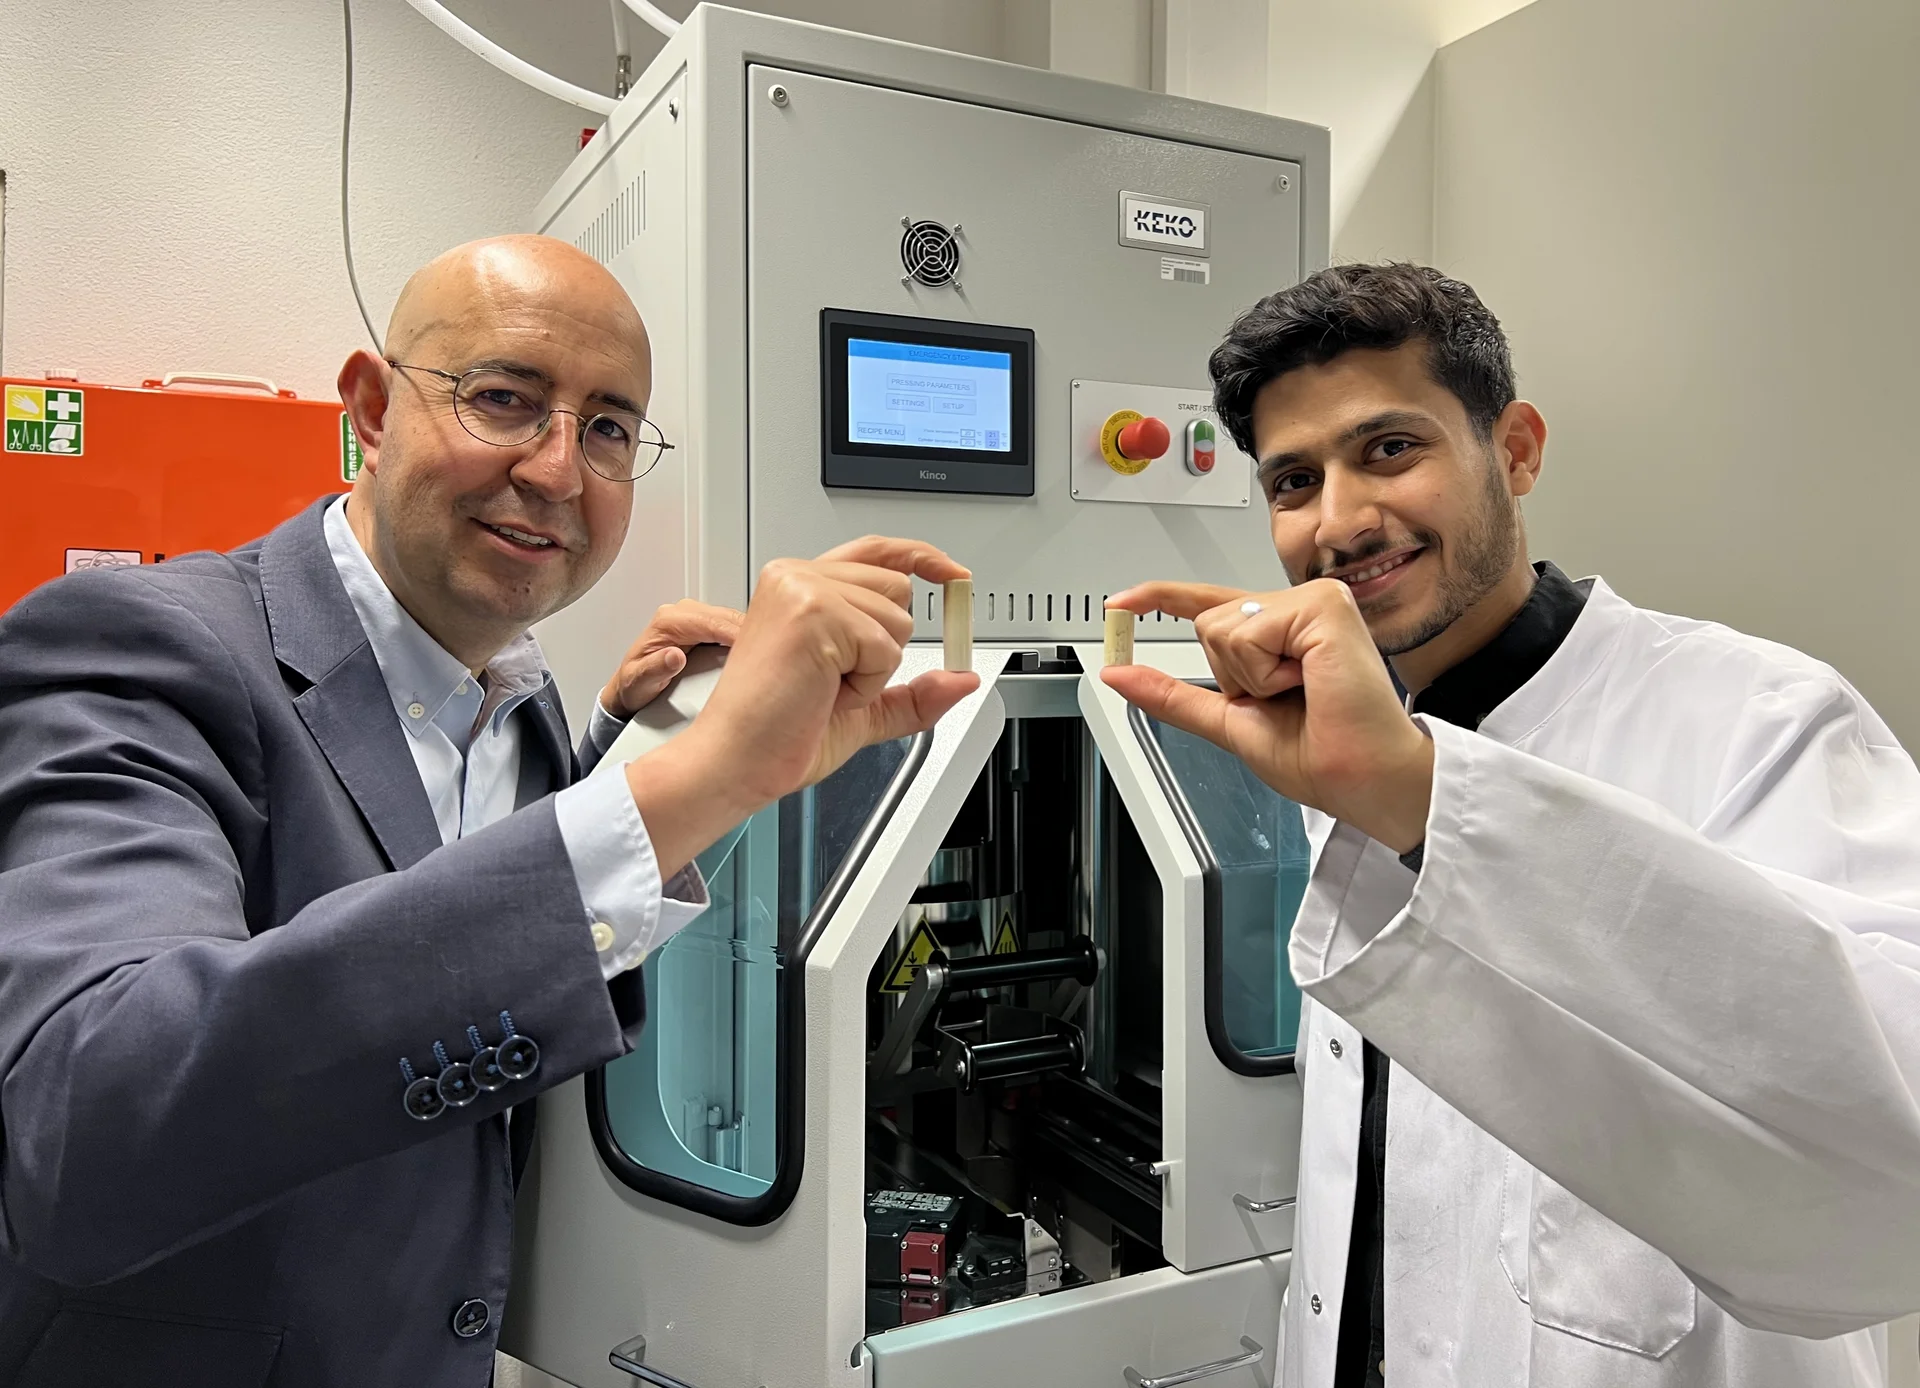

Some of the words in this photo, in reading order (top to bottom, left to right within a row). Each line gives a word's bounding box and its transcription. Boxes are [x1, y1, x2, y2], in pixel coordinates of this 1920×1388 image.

[1134, 209, 1197, 238] KEKO
[891, 378, 925, 388] PRESSING
[926, 381, 970, 391] PARAMETERS
[891, 398, 925, 407] SETTINGS
[942, 402, 964, 410] SETUP
[1178, 403, 1198, 411] START
[857, 426, 883, 435] RECIPE
[884, 428, 905, 436] MENU
[919, 470, 947, 480] Kinco
